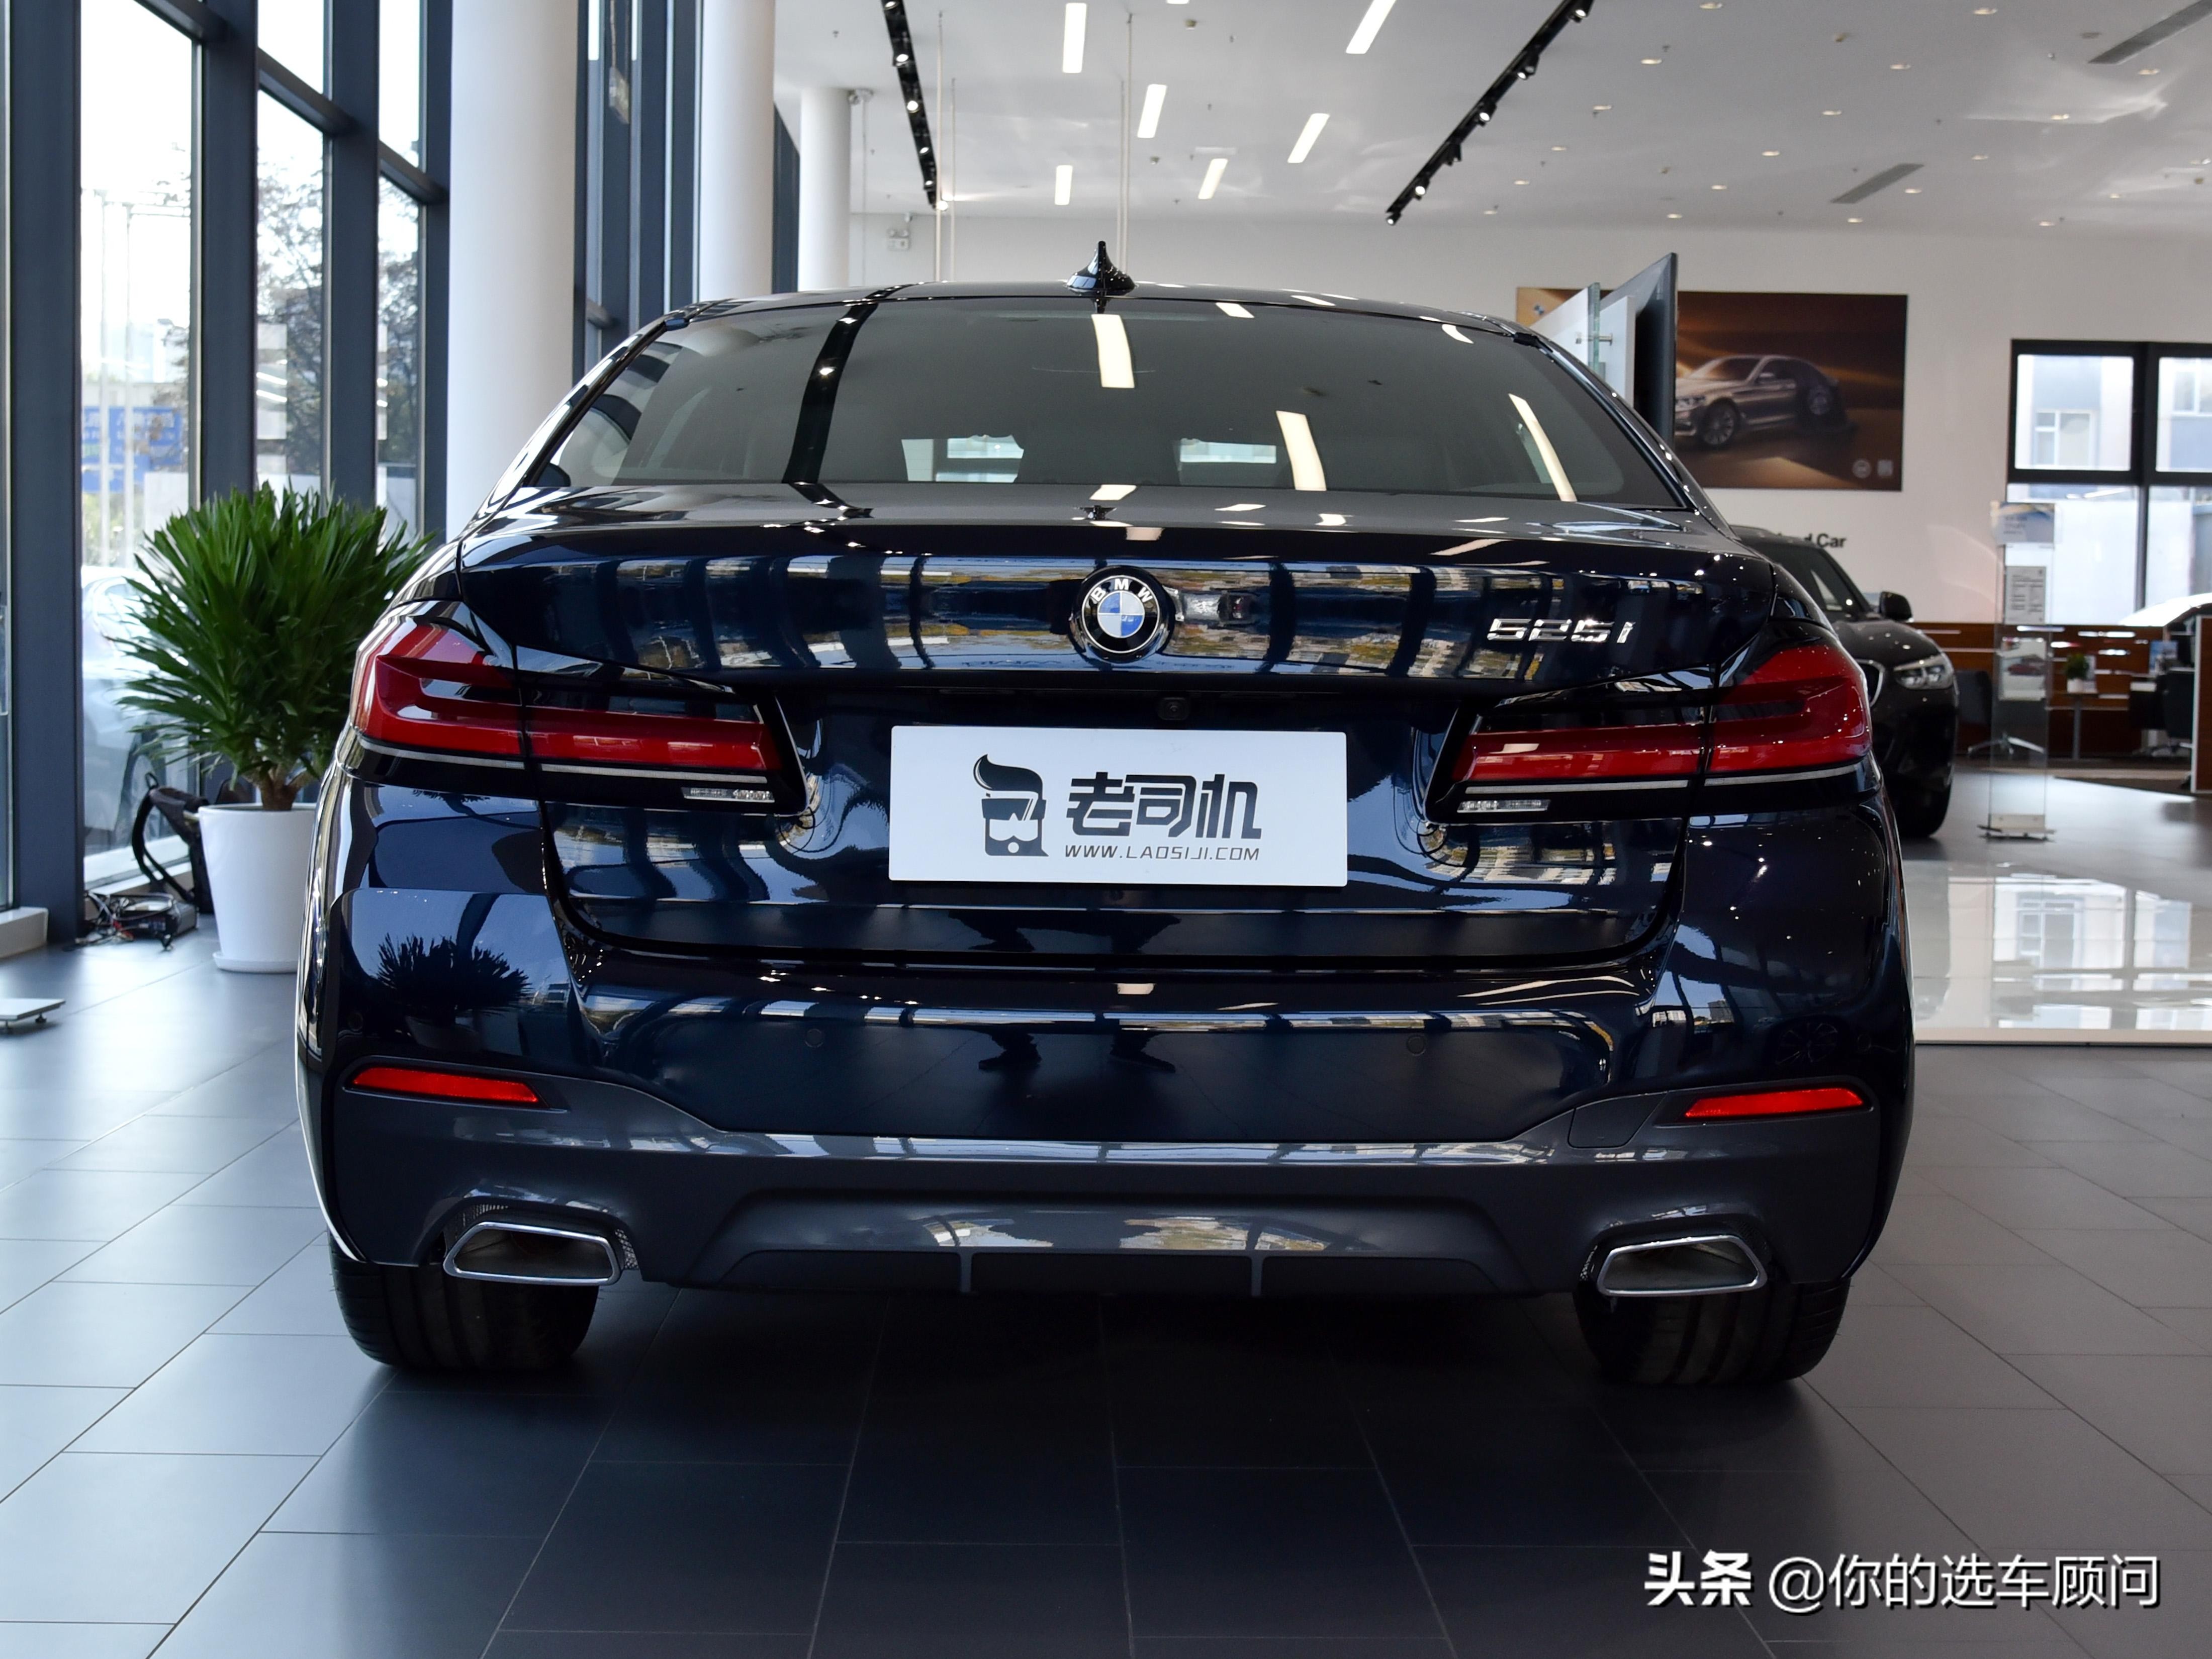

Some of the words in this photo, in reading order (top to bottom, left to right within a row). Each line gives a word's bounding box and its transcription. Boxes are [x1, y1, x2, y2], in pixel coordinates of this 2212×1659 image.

[1816, 533, 1846, 548] Car
[1090, 579, 1153, 603] BMW
[1066, 772, 1262, 839] 老司机
[1065, 845, 1260, 861] WWW.LAOSIJI.COM
